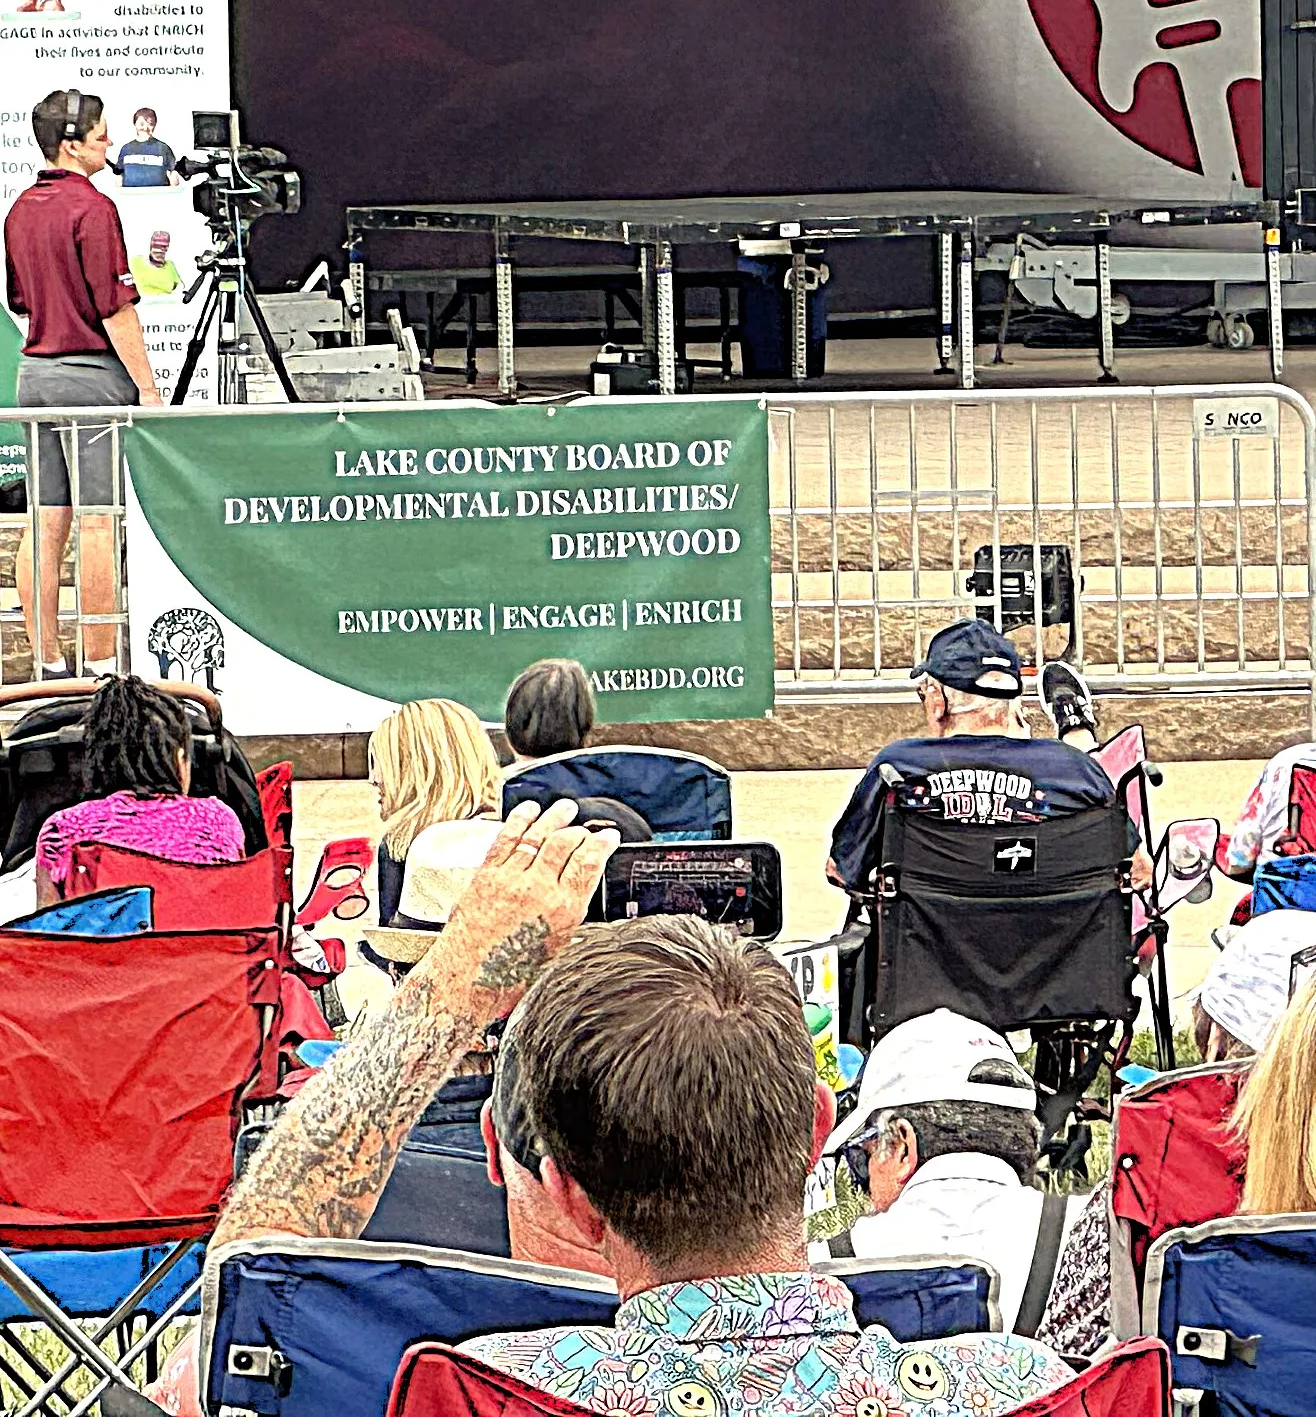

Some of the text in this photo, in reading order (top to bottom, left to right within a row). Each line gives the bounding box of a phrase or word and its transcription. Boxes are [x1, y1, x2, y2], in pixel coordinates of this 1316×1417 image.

[114, 5, 204, 16] disabilities to
[59, 27, 118, 38] activities
[122, 26, 149, 37] that
[154, 25, 204, 36] ENRICH
[35, 45, 204, 58] their lives and contribute
[80, 67, 93, 77] to
[98, 68, 121, 77] our
[1205, 412, 1262, 425] SNCO
[335, 440, 731, 476] LAKE COUNTY BOARD OF
[225, 484, 740, 524] DEVELOPMENTAL DISABILITIES/
[551, 529, 741, 559] DEEPWOOD
[338, 608, 483, 633] EMPOWER
[503, 602, 616, 629] ENGAGE
[636, 599, 742, 625] ENRICH
[591, 666, 744, 692] AKEBDD.ORG
[927, 769, 1032, 800] DEEPWOOD
